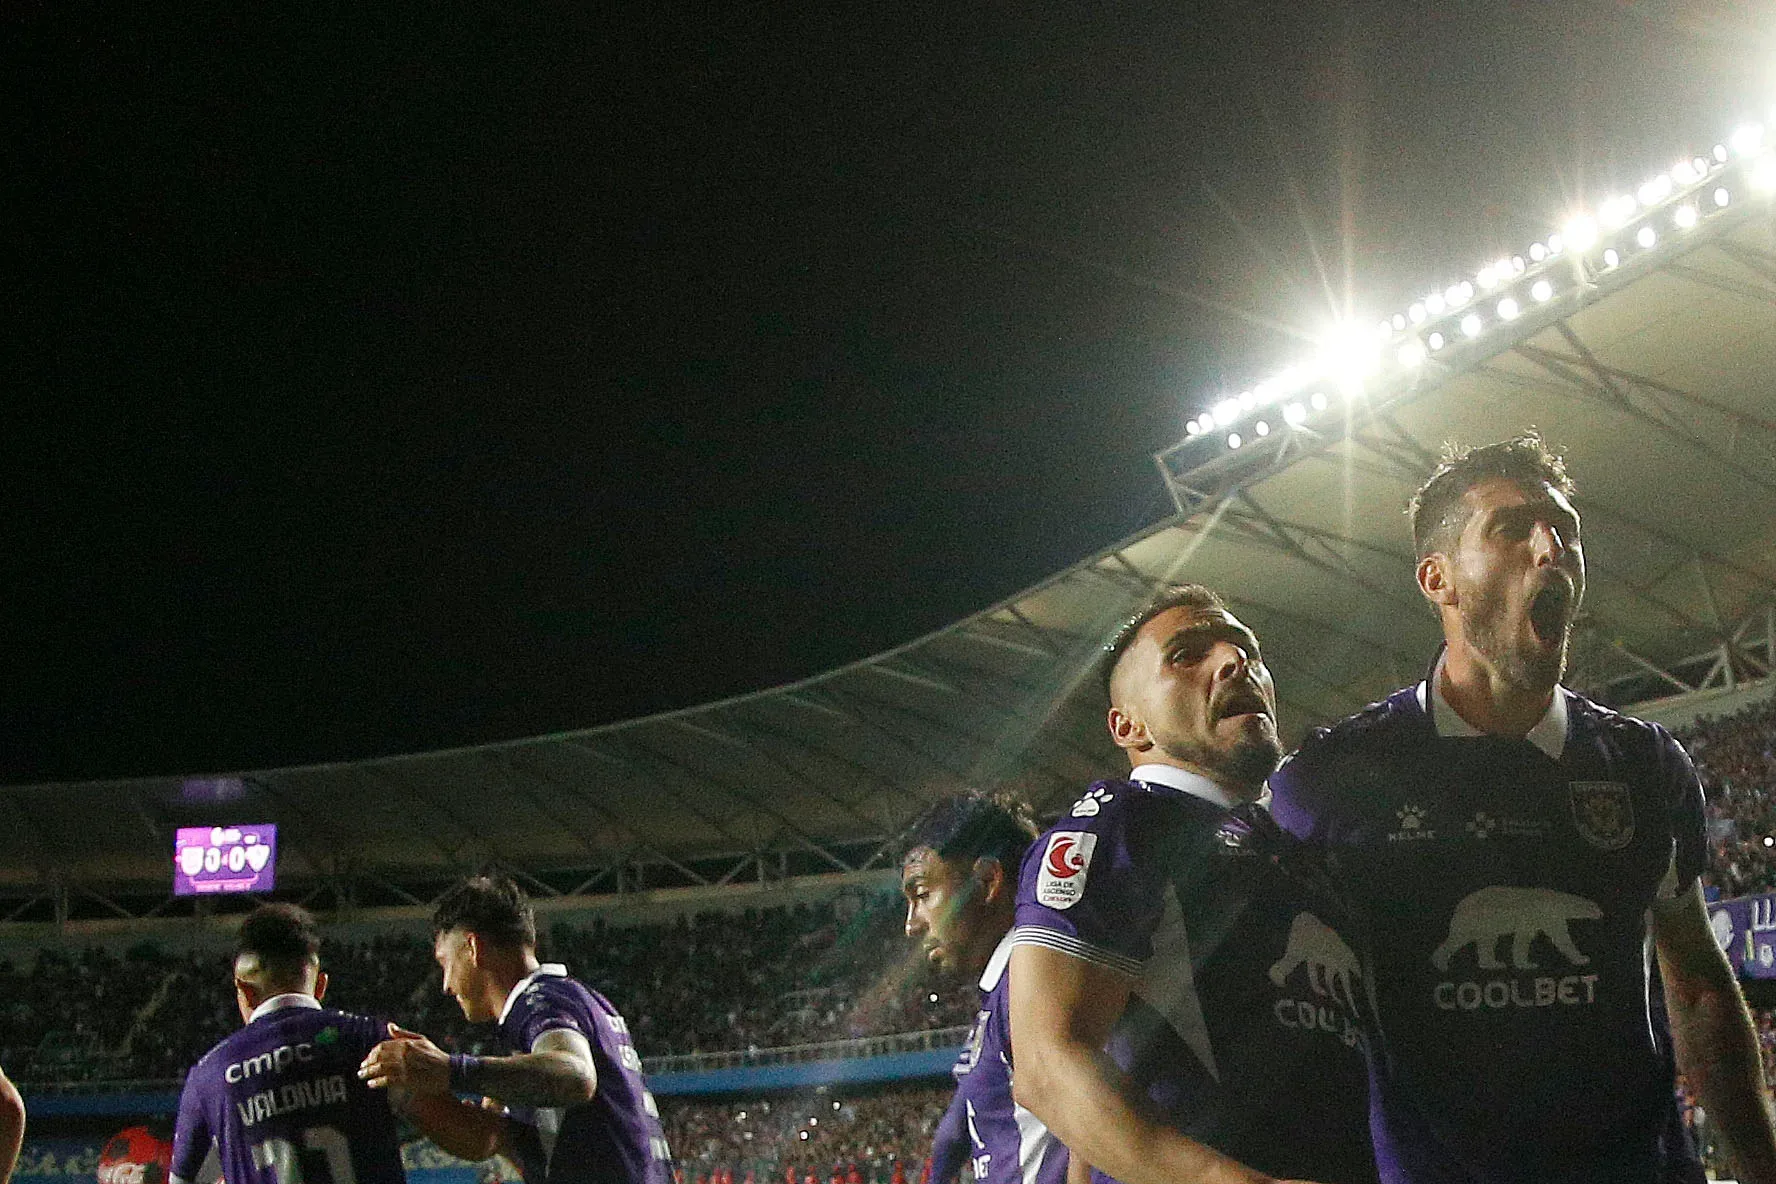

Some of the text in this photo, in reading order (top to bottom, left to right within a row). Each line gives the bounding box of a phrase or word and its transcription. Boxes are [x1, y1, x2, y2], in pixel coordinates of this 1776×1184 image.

[1433, 974, 1599, 1010] COOLBET
[224, 1043, 313, 1084] cmpc
[237, 1074, 348, 1127] VALDIVIA
